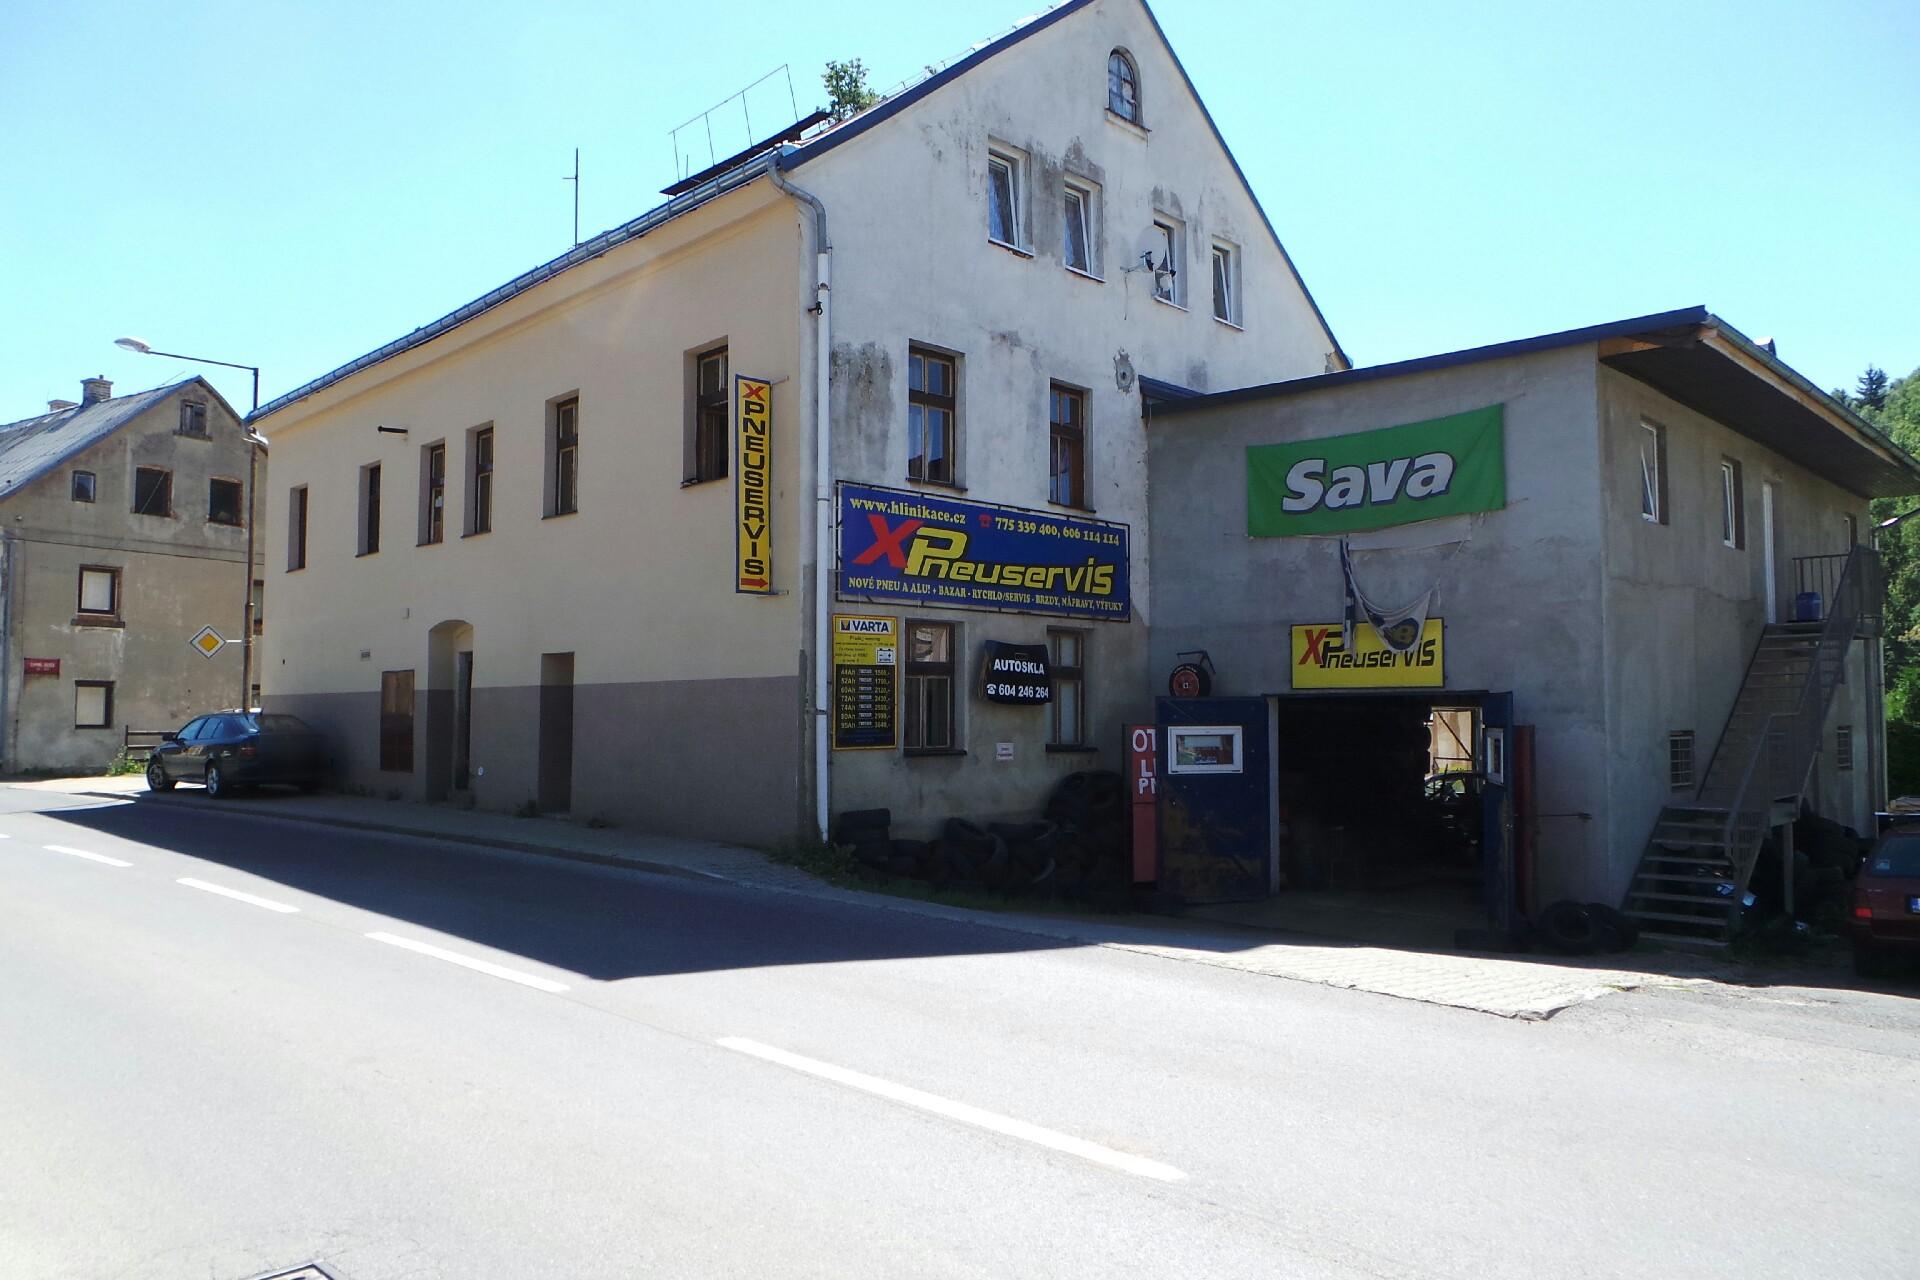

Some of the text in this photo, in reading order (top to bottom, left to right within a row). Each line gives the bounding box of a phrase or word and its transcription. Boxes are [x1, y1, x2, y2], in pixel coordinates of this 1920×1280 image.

[1282, 452, 1454, 513] Sava
[850, 498, 966, 525] www.hlinikace.cz
[995, 517, 1119, 546] 775 339 400, 606 114 114
[848, 576, 875, 589] NOVÉ
[876, 579, 900, 592] PNEU
[902, 582, 909, 592] A
[910, 582, 931, 595] ALU!
[938, 585, 967, 598] BAZAR
[853, 620, 889, 632] VARTA
[994, 658, 1045, 675] AUTOSKLA
[999, 683, 1049, 699] 604 246 264
